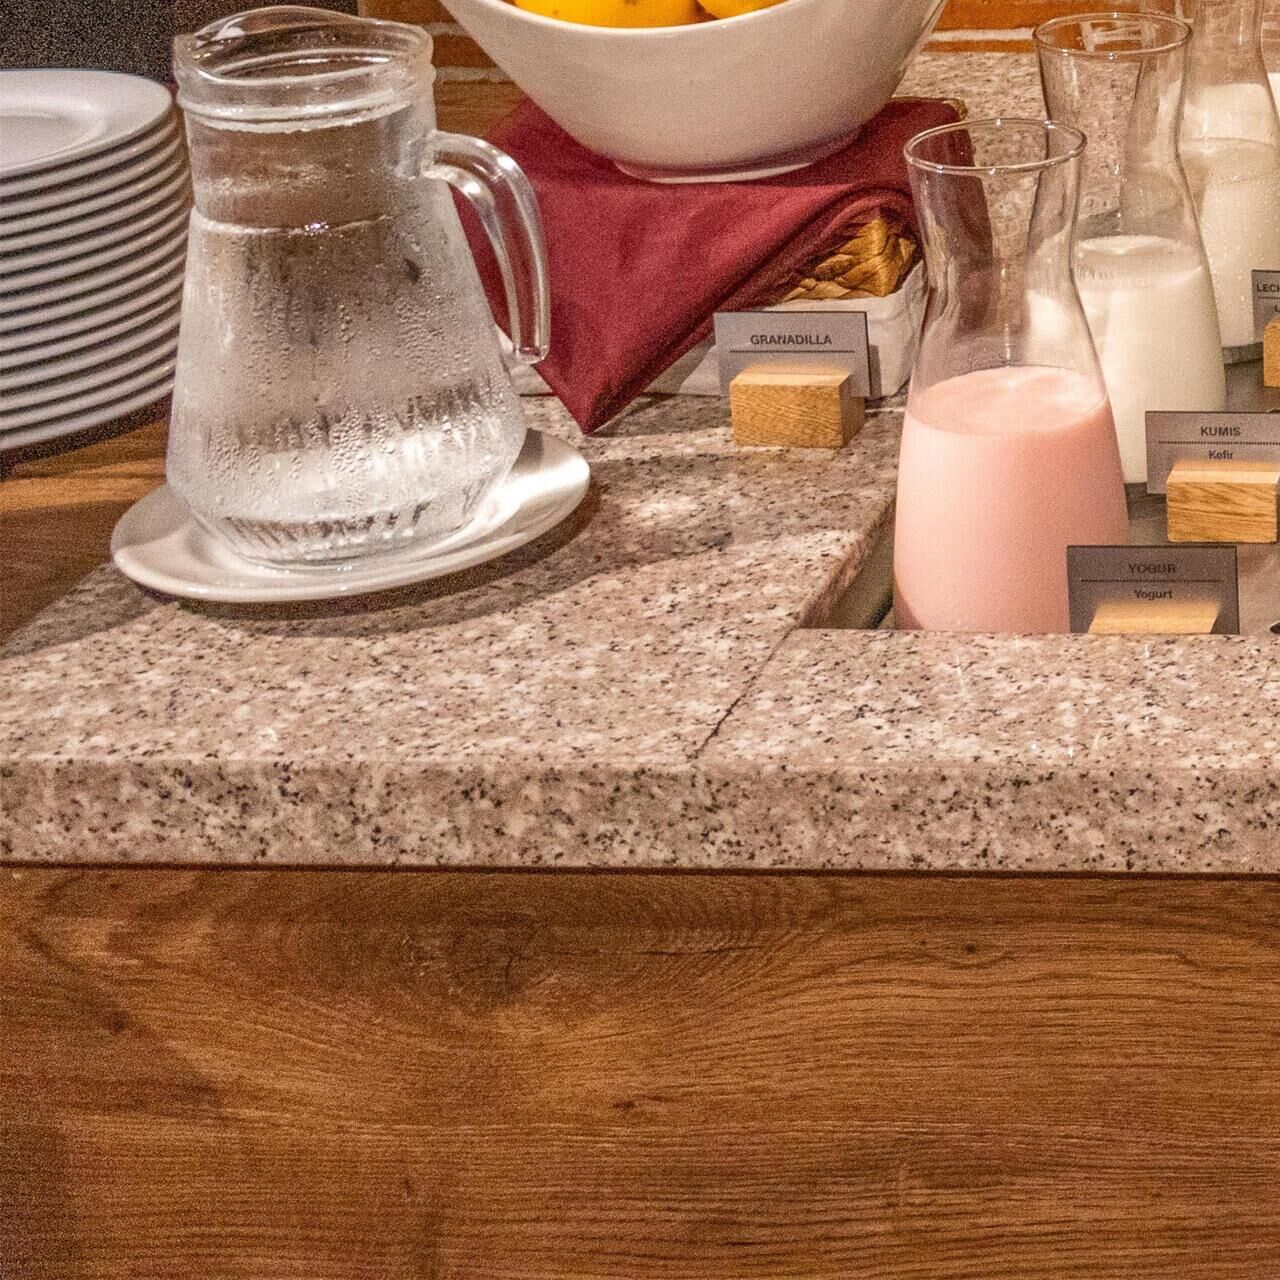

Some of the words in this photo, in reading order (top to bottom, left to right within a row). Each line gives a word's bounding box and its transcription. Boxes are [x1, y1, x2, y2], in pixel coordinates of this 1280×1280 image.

[750, 334, 833, 345] GRANADILLA
[1200, 427, 1241, 436] KUMIS
[1128, 564, 1176, 573] YOGUR
[1135, 589, 1173, 600] Yogurt
